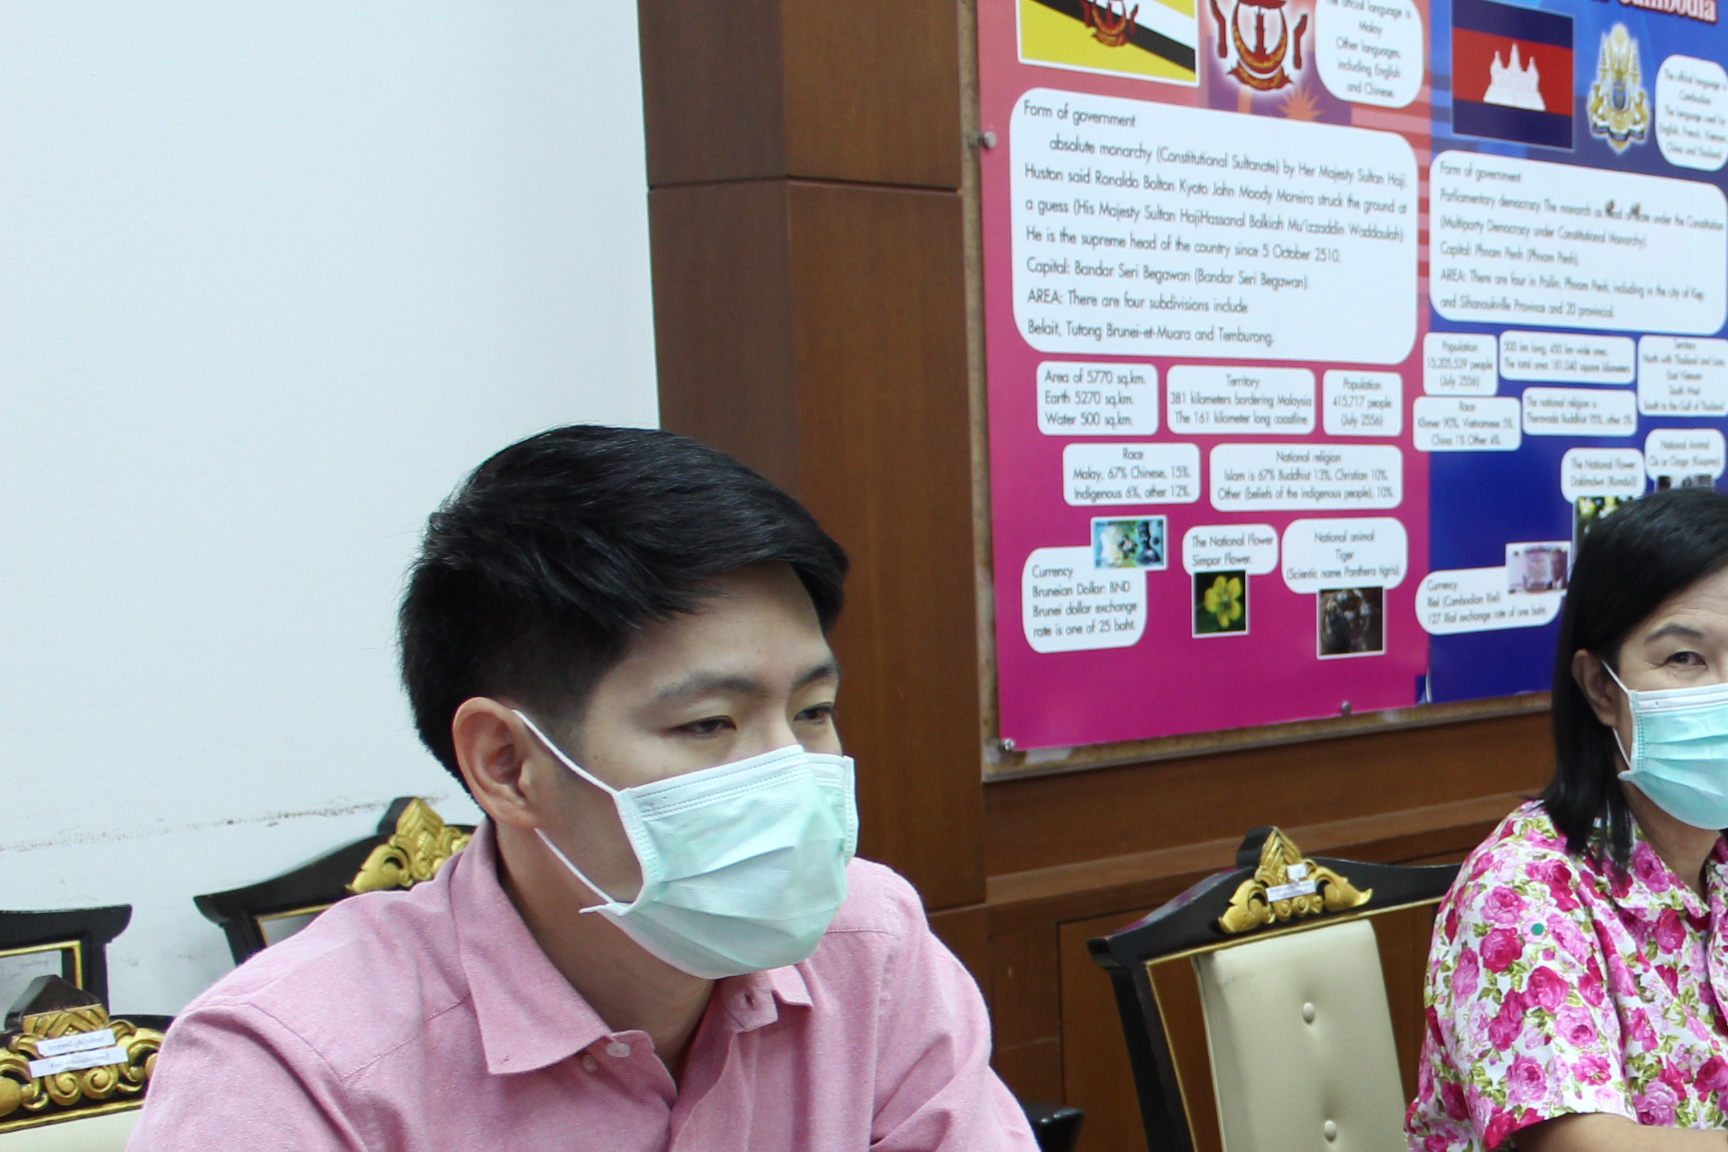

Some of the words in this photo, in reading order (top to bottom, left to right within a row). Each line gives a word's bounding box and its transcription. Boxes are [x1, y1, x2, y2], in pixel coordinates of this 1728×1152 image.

[1024, 99, 1052, 116] Form
[1056, 102, 1068, 119] of
[1072, 110, 1135, 125] government
[1049, 134, 1094, 152] absolute
[1099, 143, 1152, 161] monarchy
[1283, 158, 1294, 177] by
[1298, 163, 1315, 175] Her
[1318, 165, 1354, 182] Majesty
[1357, 167, 1384, 183] Sultan
[1440, 160, 1461, 174] Form
[1464, 162, 1472, 176] of
[1475, 169, 1521, 181] government
[1025, 163, 1063, 179] Huston
[1068, 167, 1090, 183] said
[1095, 169, 1139, 187] Ronaldo
[1212, 180, 1234, 196] John
[1239, 185, 1272, 202] Moody
[1346, 193, 1360, 207] the
[1363, 200, 1395, 213] ground
[1398, 203, 1407, 213] at
[1025, 198, 1033, 210] a
[1037, 200, 1068, 214] guess
[1073, 198, 1094, 214] (His
[1098, 202, 1140, 221] Majesty
[1144, 204, 1175, 220] Sultan
[1026, 226, 1042, 240] He
[1046, 227, 1055, 242] is
[1059, 226, 1076, 243] the
[1081, 234, 1125, 248] supreme
[1130, 232, 1156, 249] head
[1160, 234, 1171, 250] of
[1175, 236, 1190, 251] the
[1194, 242, 1230, 257] country
[1234, 245, 1258, 256] since
[1262, 242, 1269, 257] 5
[1272, 243, 1310, 259] October
[1026, 256, 1070, 275] Capital:
[1074, 259, 1114, 276] Bandar
[1118, 262, 1138, 277] Seri
[1143, 264, 1190, 283] Begawan
[1194, 267, 1234, 283] (Bandar
[1238, 270, 1256, 284] Seri
[1027, 287, 1062, 303] AREA:
[1067, 288, 1097, 305] There
[1101, 296, 1119, 306] are
[1124, 290, 1144, 307] four
[1149, 294, 1209, 310] subdivisions
[1213, 297, 1247, 312] include
[1194, 325, 1213, 340] and
[1044, 369, 1069, 382] Area
[1073, 367, 1083, 383] of
[1087, 369, 1112, 383] 5770
[1226, 374, 1259, 388] Territory
[1343, 377, 1380, 390] Population
[1044, 389, 1070, 403] Earth
[1074, 390, 1101, 404] 5270
[1045, 412, 1076, 424] Water
[1080, 411, 1100, 425] 500
[1122, 447, 1143, 459] Race
[1276, 451, 1309, 462] National
[1313, 450, 1340, 465] religion
[1032, 564, 1073, 578] Currency
[1032, 604, 1061, 617] Brunei
[1065, 600, 1091, 614] dollar
[1095, 600, 1136, 614] exchange
[1033, 626, 1051, 636] rate
[1055, 624, 1062, 635] is
[1065, 625, 1082, 634] one
[1086, 618, 1095, 633] of
[1099, 619, 1110, 632] 25
